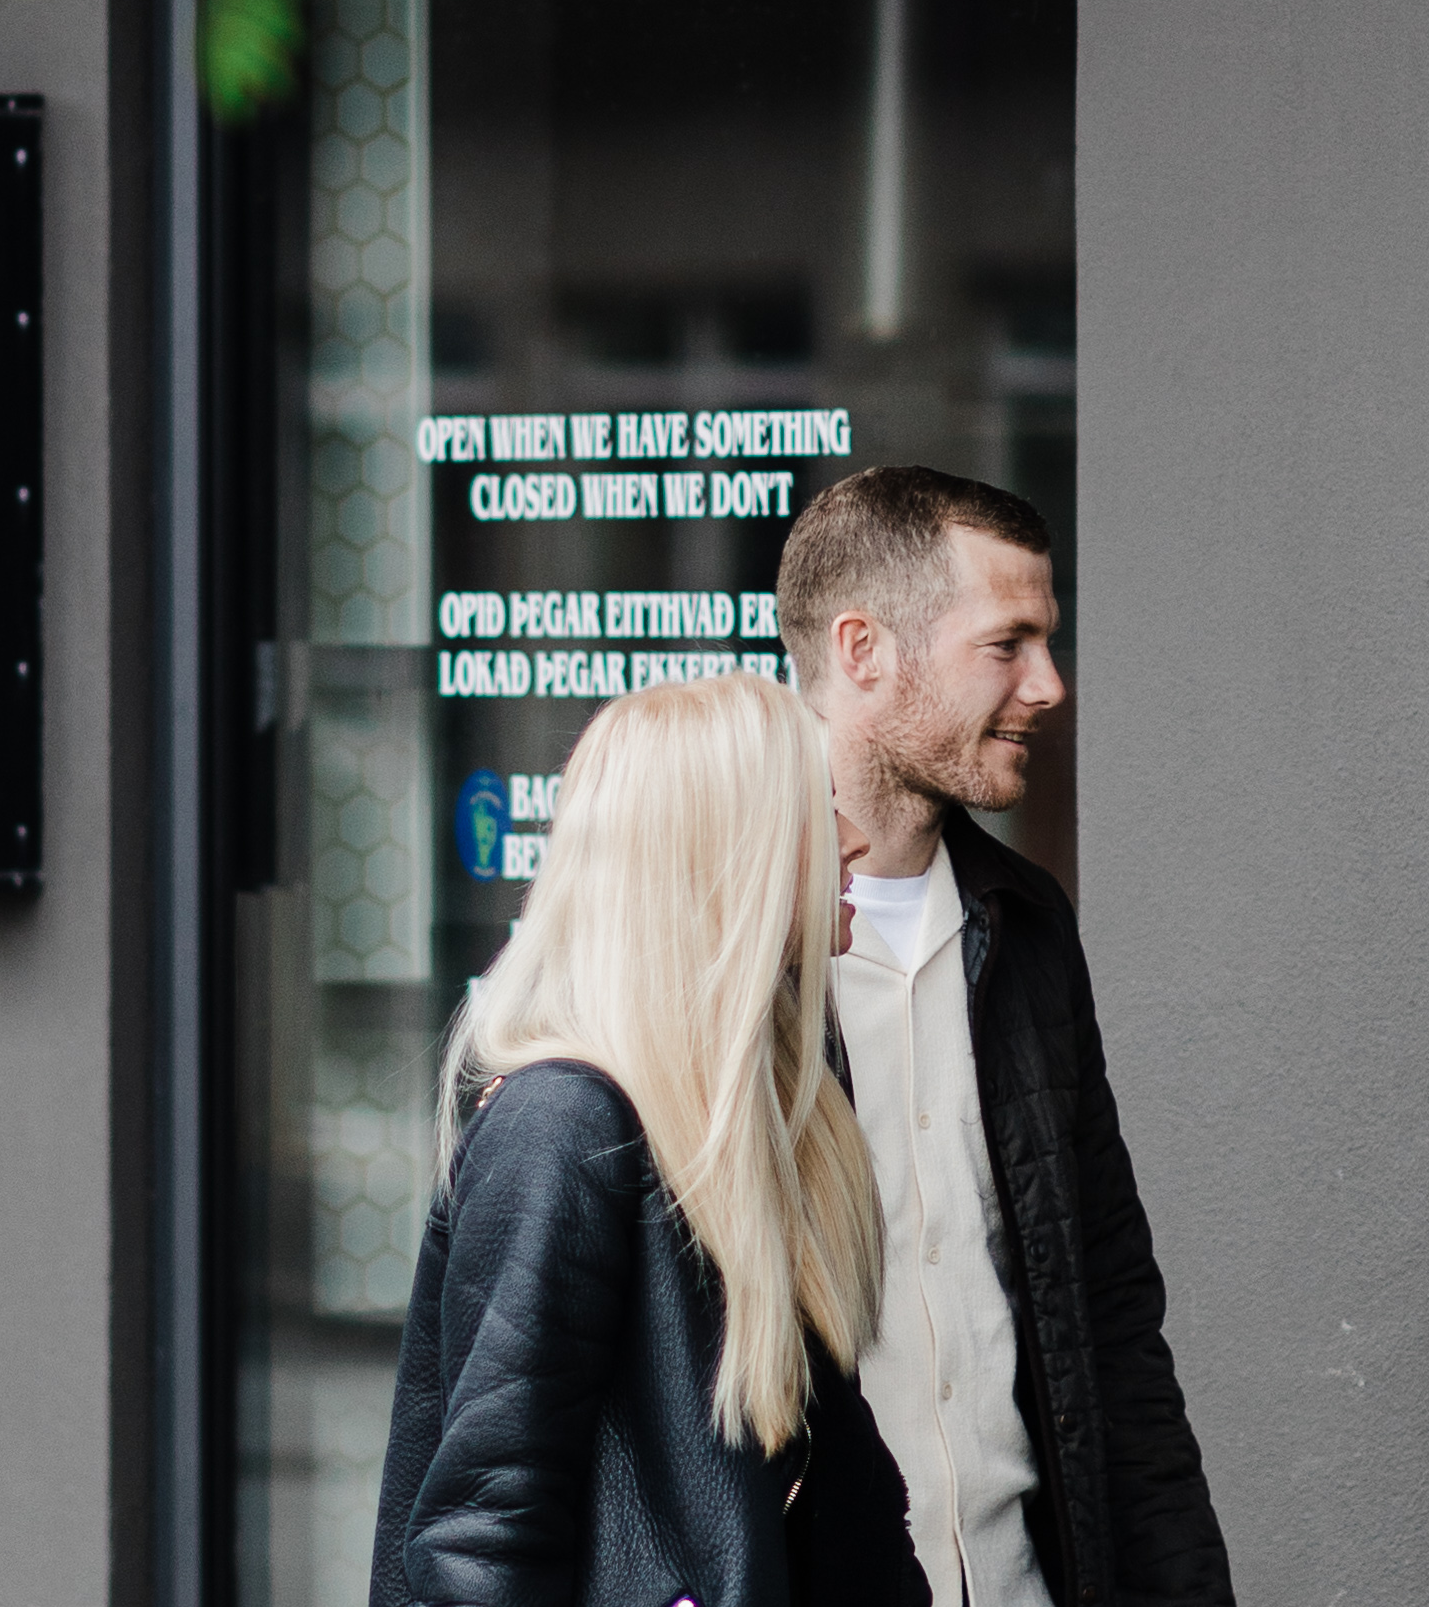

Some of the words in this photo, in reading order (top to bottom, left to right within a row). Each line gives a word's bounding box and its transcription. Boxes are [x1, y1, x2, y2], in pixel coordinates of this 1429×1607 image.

[419, 415, 486, 461] OPEN
[489, 415, 566, 460] WHEN
[571, 414, 612, 459] WE
[617, 412, 690, 458] HAVE
[694, 409, 851, 457] SOMETHING
[471, 474, 576, 520] CLOSED
[581, 473, 659, 517] WHEN
[663, 472, 706, 517] WE
